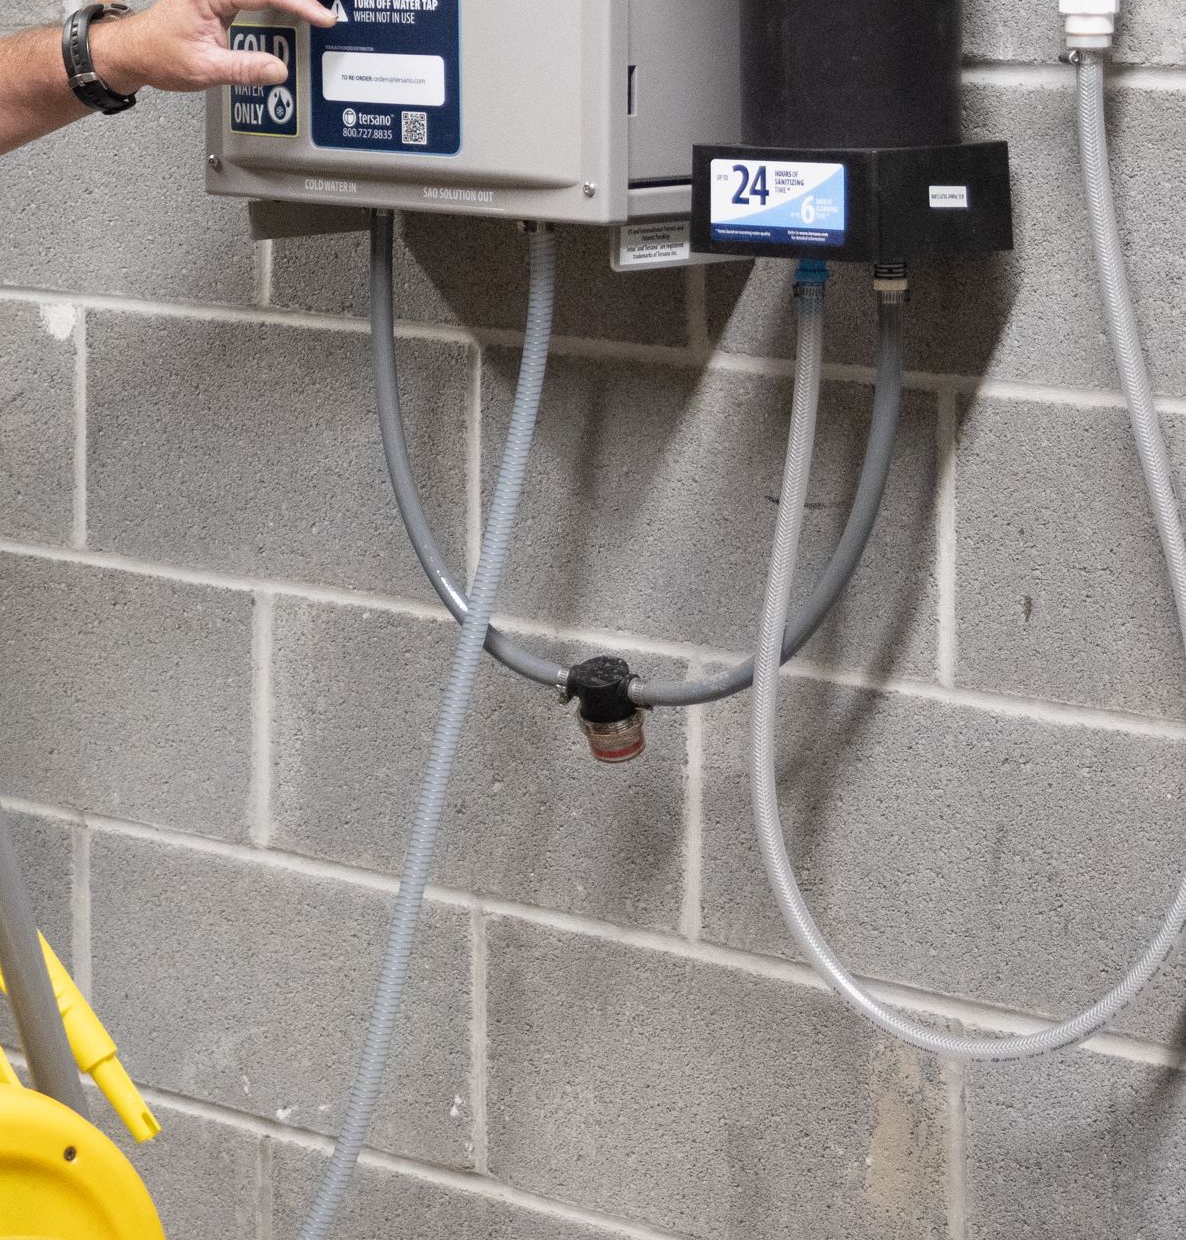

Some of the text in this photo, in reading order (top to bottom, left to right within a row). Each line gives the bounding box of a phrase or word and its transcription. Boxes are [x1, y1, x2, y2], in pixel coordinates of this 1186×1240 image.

[422, 0, 438, 11] TAP
[353, 11, 415, 24] WHEN NOT IN USE
[234, 84, 264, 97] WATER
[234, 102, 264, 125] ONLY
[342, 127, 393, 140] 800.727.8835
[304, 179, 357, 193] COLD WATER IN
[731, 164, 770, 205] 24
[423, 187, 493, 203] SAO SOLUTION OUT
[801, 195, 815, 224] 6
